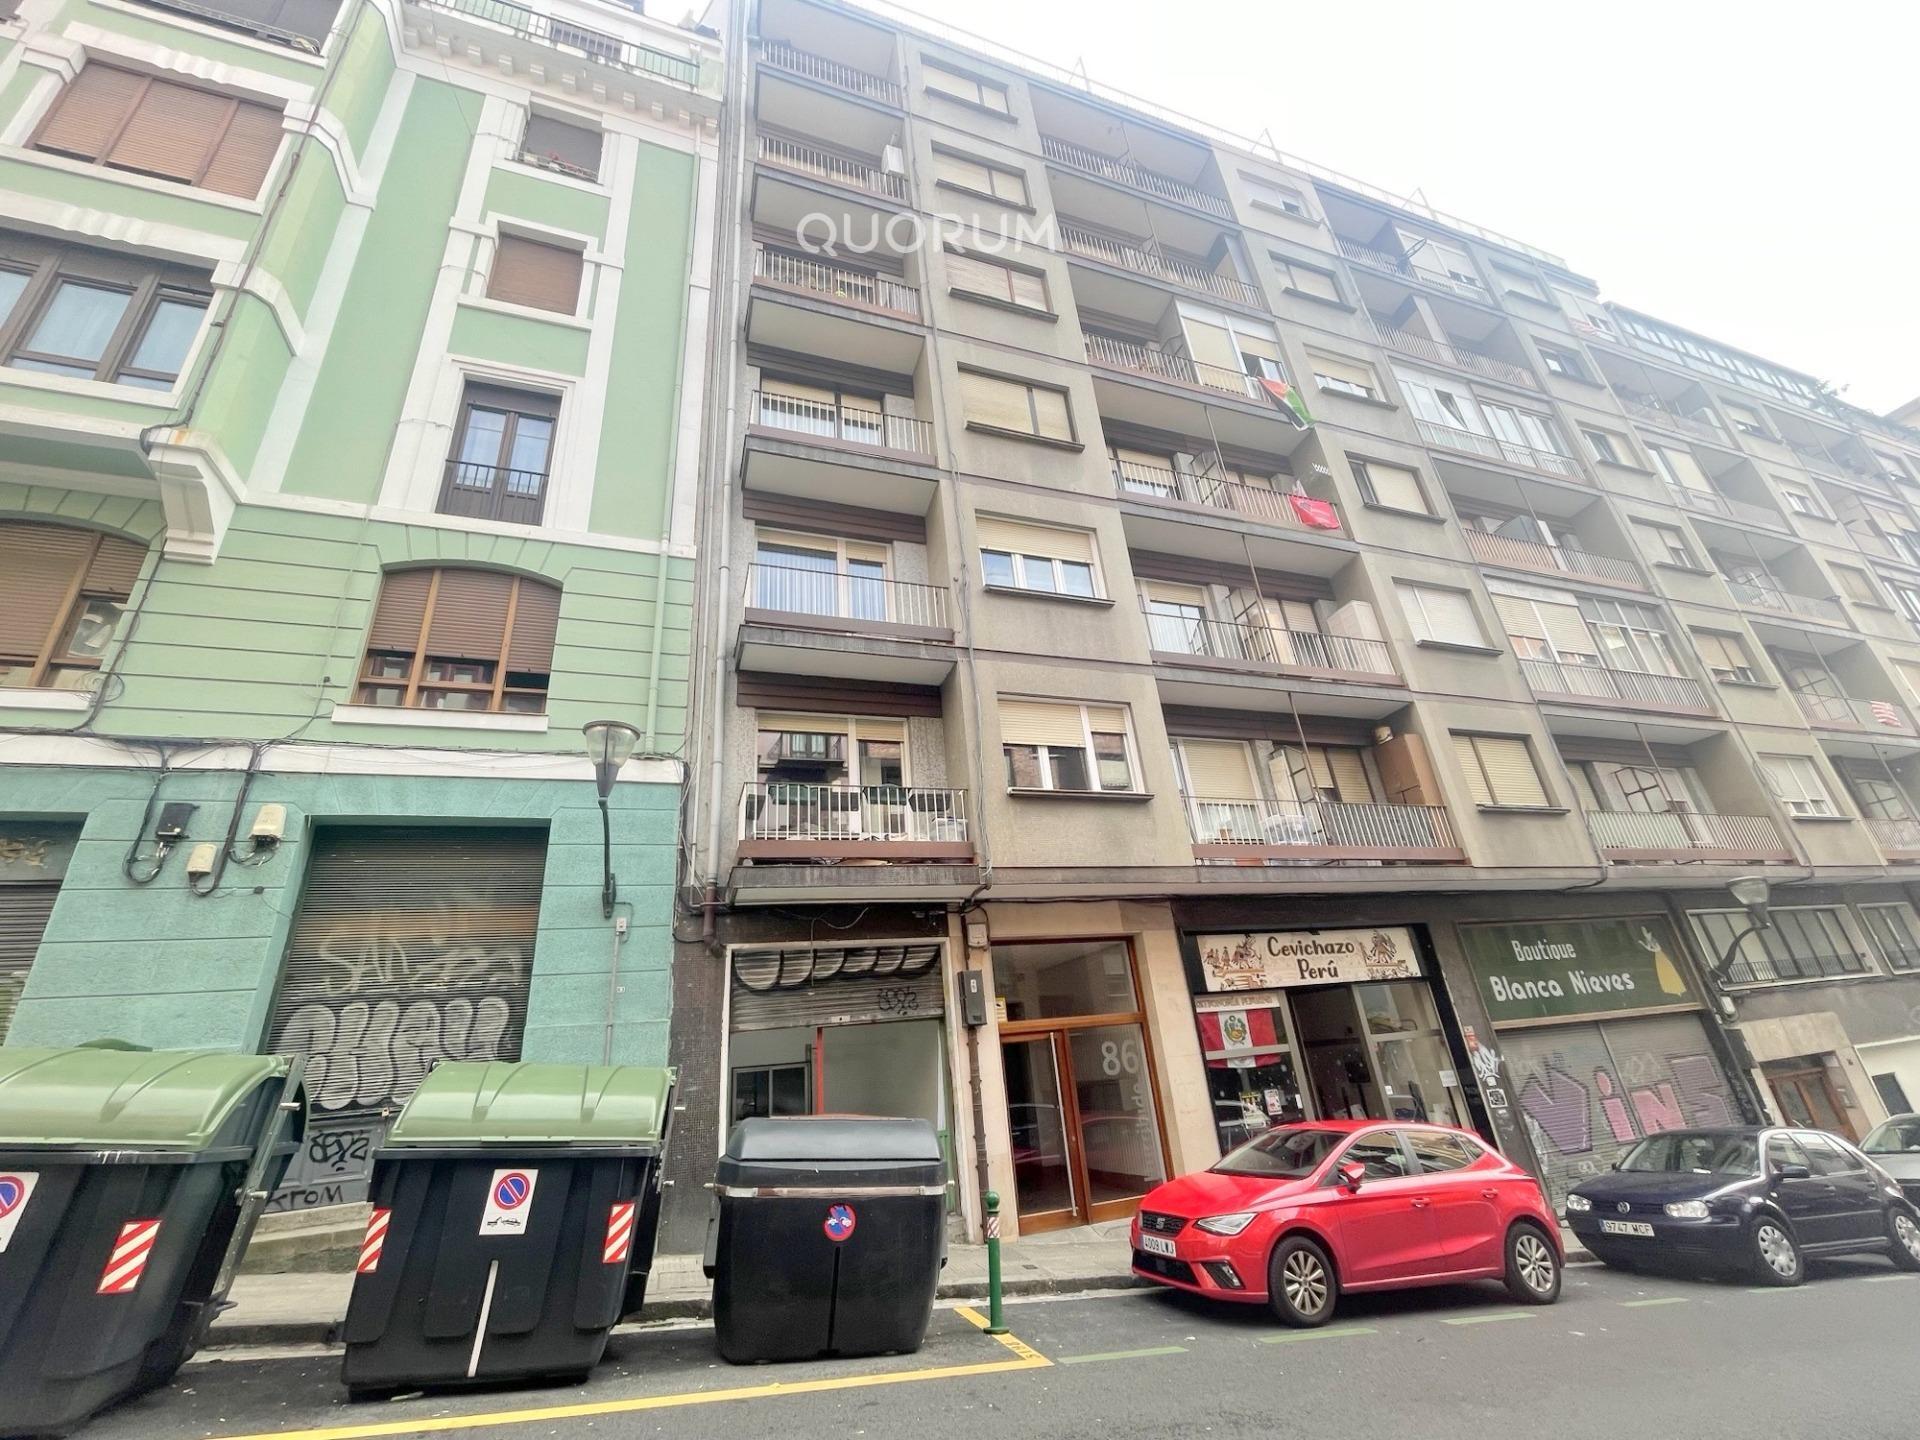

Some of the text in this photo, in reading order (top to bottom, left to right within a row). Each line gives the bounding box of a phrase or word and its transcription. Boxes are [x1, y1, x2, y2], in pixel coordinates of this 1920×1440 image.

[1267, 936, 1355, 957] Cevichazo
[1511, 939, 1577, 962] Boutique
[1297, 958, 1339, 980] Perú
[1489, 970, 1635, 1002] Blanca Nieves
[1101, 1039, 1138, 1076] 86
